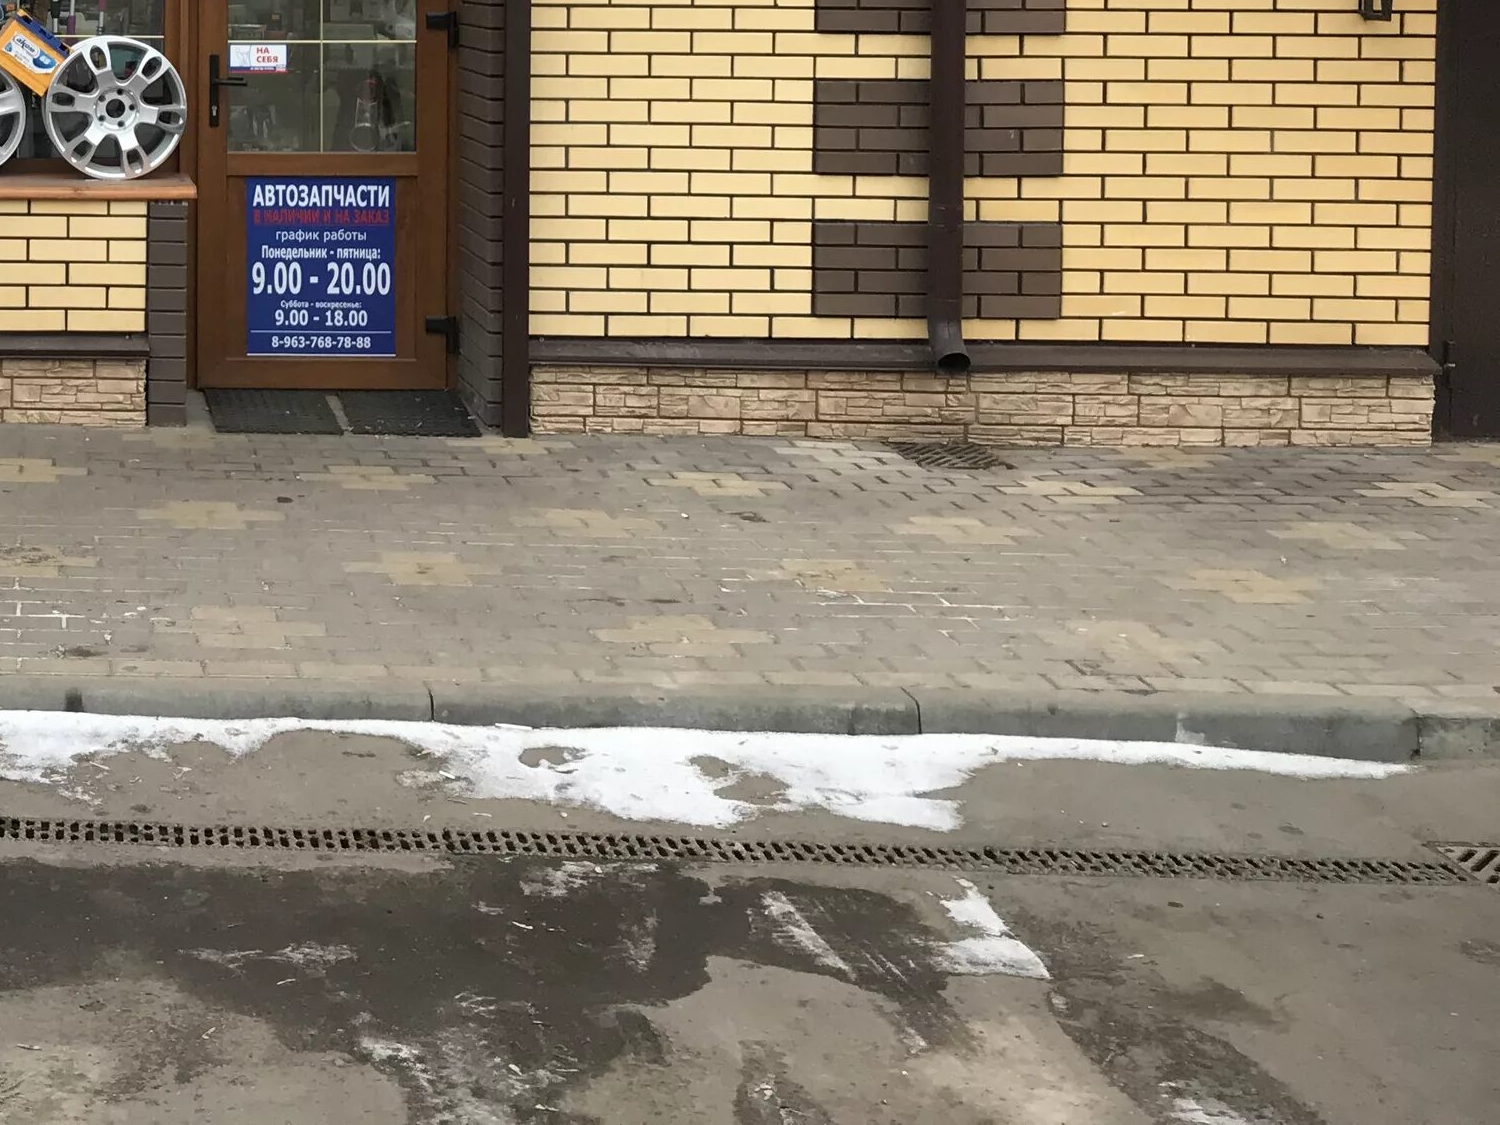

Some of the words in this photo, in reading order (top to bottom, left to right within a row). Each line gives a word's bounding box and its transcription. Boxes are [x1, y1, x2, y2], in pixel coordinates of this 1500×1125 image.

[256, 46, 270, 55] НА
[256, 55, 279, 64] СЕБЯ
[252, 184, 390, 207] АВТОЗАПЧАСТИ
[253, 209, 260, 224] В
[323, 210, 331, 224] И
[335, 210, 350, 224] НА
[354, 210, 389, 225] ЗАКАЗ
[275, 228, 320, 243] график
[323, 229, 367, 243] работы
[261, 245, 328, 260] Понедельник
[336, 248, 381, 261] пятница:
[251, 261, 302, 295] 9.00
[326, 261, 391, 295] 20.00
[280, 300, 309, 309] Суббота
[315, 300, 362, 308] воскресенье:
[274, 309, 309, 326] 9.00
[325, 309, 368, 326] 18.00
[271, 335, 371, 349] 8-963-768-78-88
